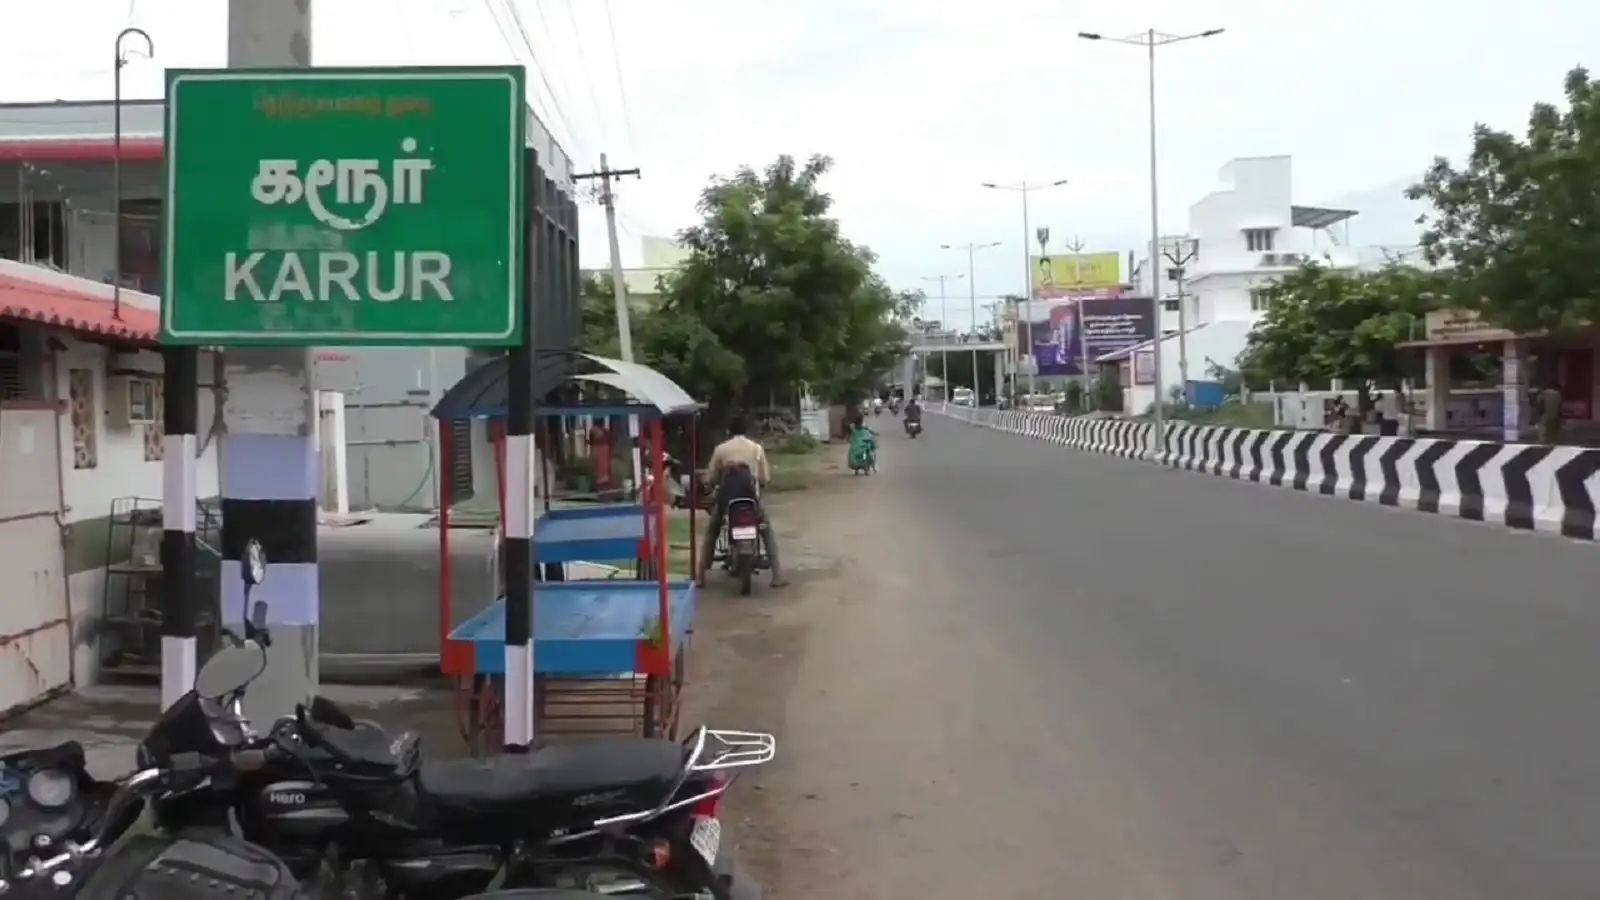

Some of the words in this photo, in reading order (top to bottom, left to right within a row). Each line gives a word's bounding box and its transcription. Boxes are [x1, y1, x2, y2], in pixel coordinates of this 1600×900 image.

[250, 137, 431, 230] கரூர்
[224, 251, 454, 302] KARUR
[270, 792, 305, 805] Hero
